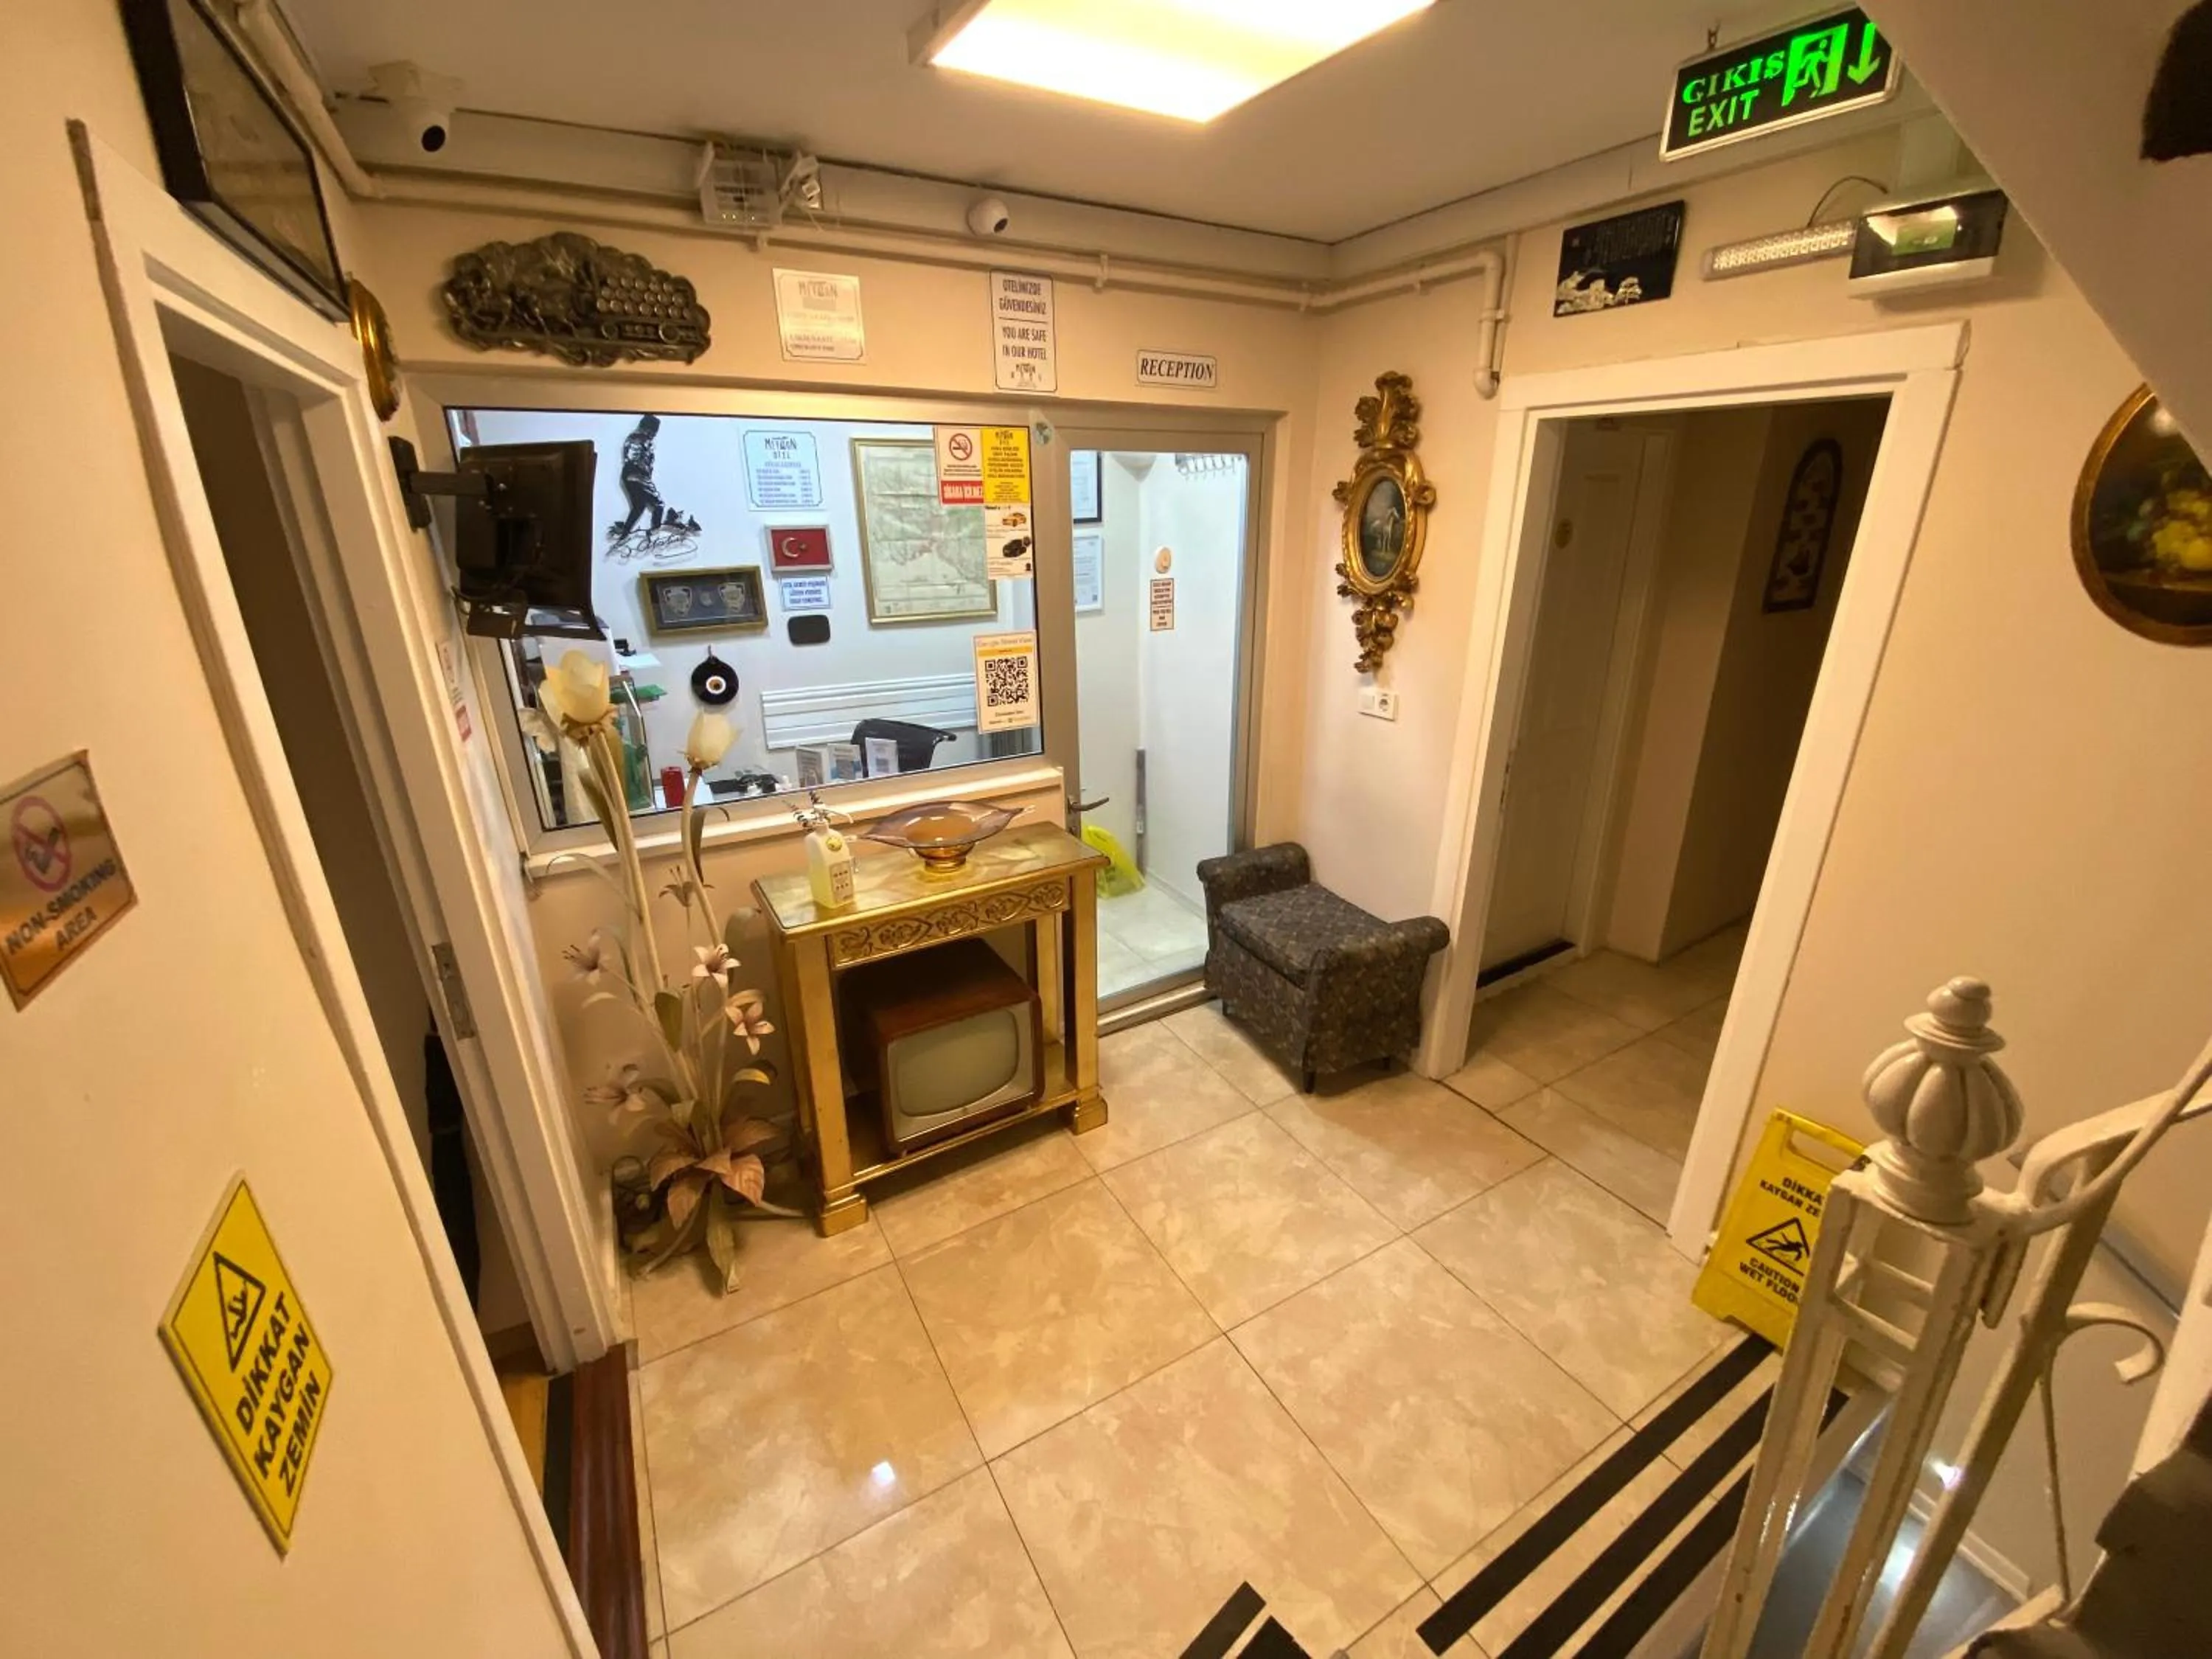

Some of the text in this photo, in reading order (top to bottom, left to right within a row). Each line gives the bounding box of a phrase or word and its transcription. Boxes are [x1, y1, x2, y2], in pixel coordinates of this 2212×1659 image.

[1688, 88, 1760, 137] EXIT
[1002, 326, 1047, 343] YOU ARE SAFE
[1002, 344, 1047, 361] IN OUR HOTEL
[1140, 358, 1214, 380] RECEPTION
[5, 858, 116, 956] NON-SMOKING
[55, 905, 97, 951] AREA
[1781, 1176, 1824, 1205] DİKKA
[1739, 1262, 1797, 1303] WET FLOO
[1749, 1256, 1800, 1293] CAUTION
[234, 1291, 291, 1437] DİKKAT
[253, 1322, 312, 1479] KAYGAN
[279, 1370, 322, 1498] ZEMİN
